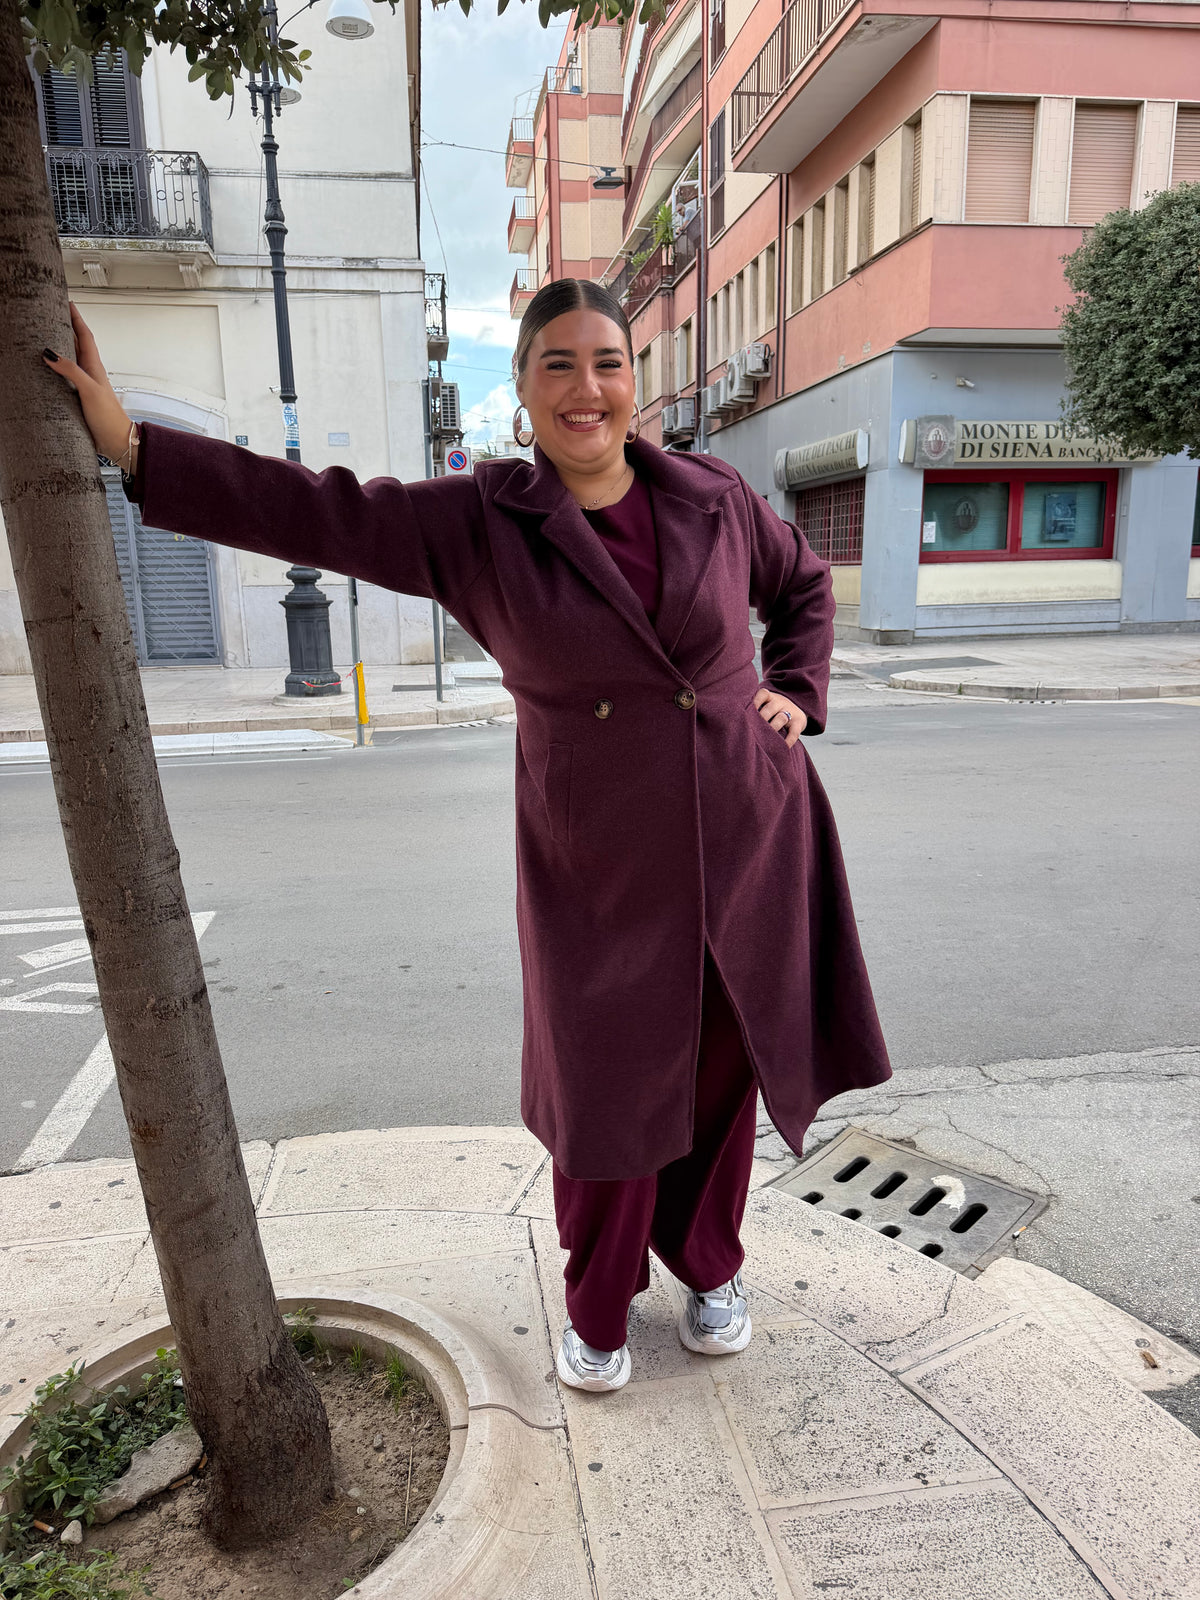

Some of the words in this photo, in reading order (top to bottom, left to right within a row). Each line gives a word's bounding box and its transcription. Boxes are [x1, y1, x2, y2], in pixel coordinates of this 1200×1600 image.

[961, 423, 1038, 439] MONTE
[826, 433, 857, 456] PASCHI
[960, 442, 984, 458] DI
[989, 442, 1053, 458] SIENA
[1058, 447, 1103, 458] BANCA
